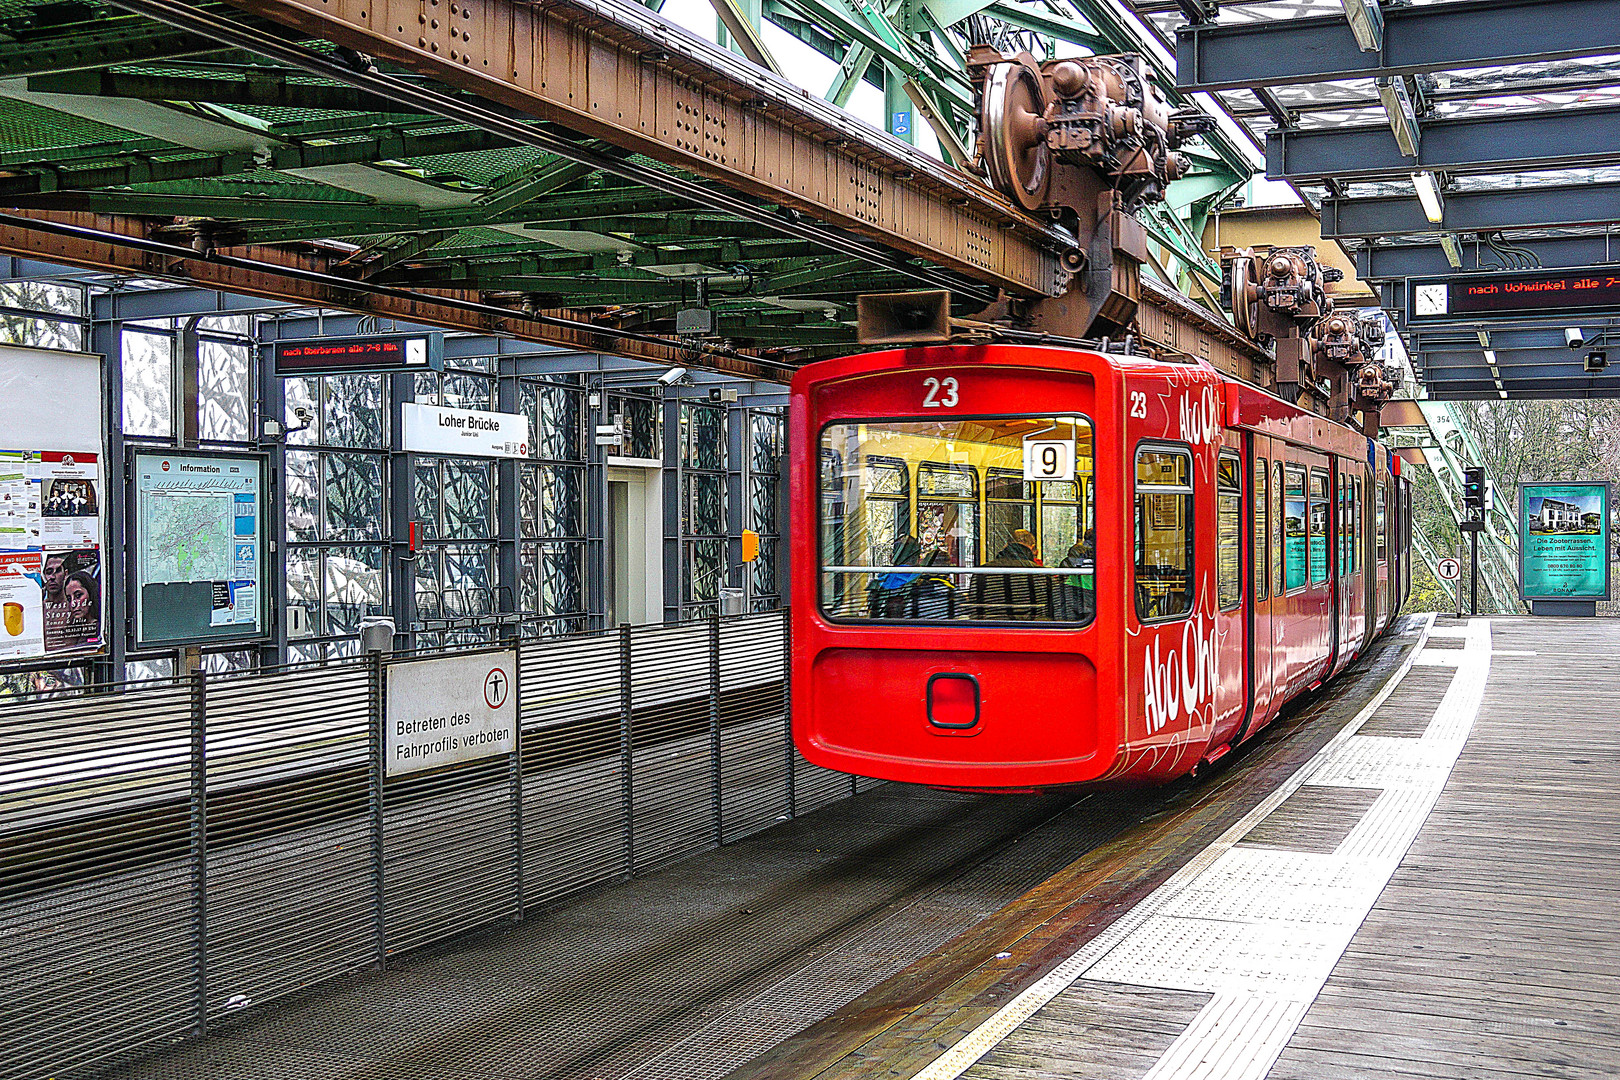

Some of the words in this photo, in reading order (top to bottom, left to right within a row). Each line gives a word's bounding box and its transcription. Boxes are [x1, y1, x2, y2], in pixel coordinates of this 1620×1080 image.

[1468, 284, 1499, 295] nach
[1504, 280, 1567, 293] Vohwinkel
[1573, 279, 1600, 289] alle
[283, 347, 302, 356] nach
[304, 347, 346, 356] Oberbarmen
[348, 345, 364, 353] alle
[366, 344, 381, 352] 7-8
[383, 343, 399, 351] Min.
[922, 376, 960, 408] 23
[1129, 390, 1147, 420] 23
[438, 413, 466, 429] Loher
[468, 415, 500, 432] Brücke
[1436, 415, 1450, 423] 354
[180, 463, 221, 473] Information
[1041, 446, 1058, 475] 9
[45, 601, 67, 609] West
[71, 598, 93, 607] Side
[45, 611, 72, 619] Story
[396, 716, 446, 736] Betreten
[450, 712, 471, 727] des
[396, 736, 458, 760] Fahrprofils
[462, 728, 509, 747] verboten
